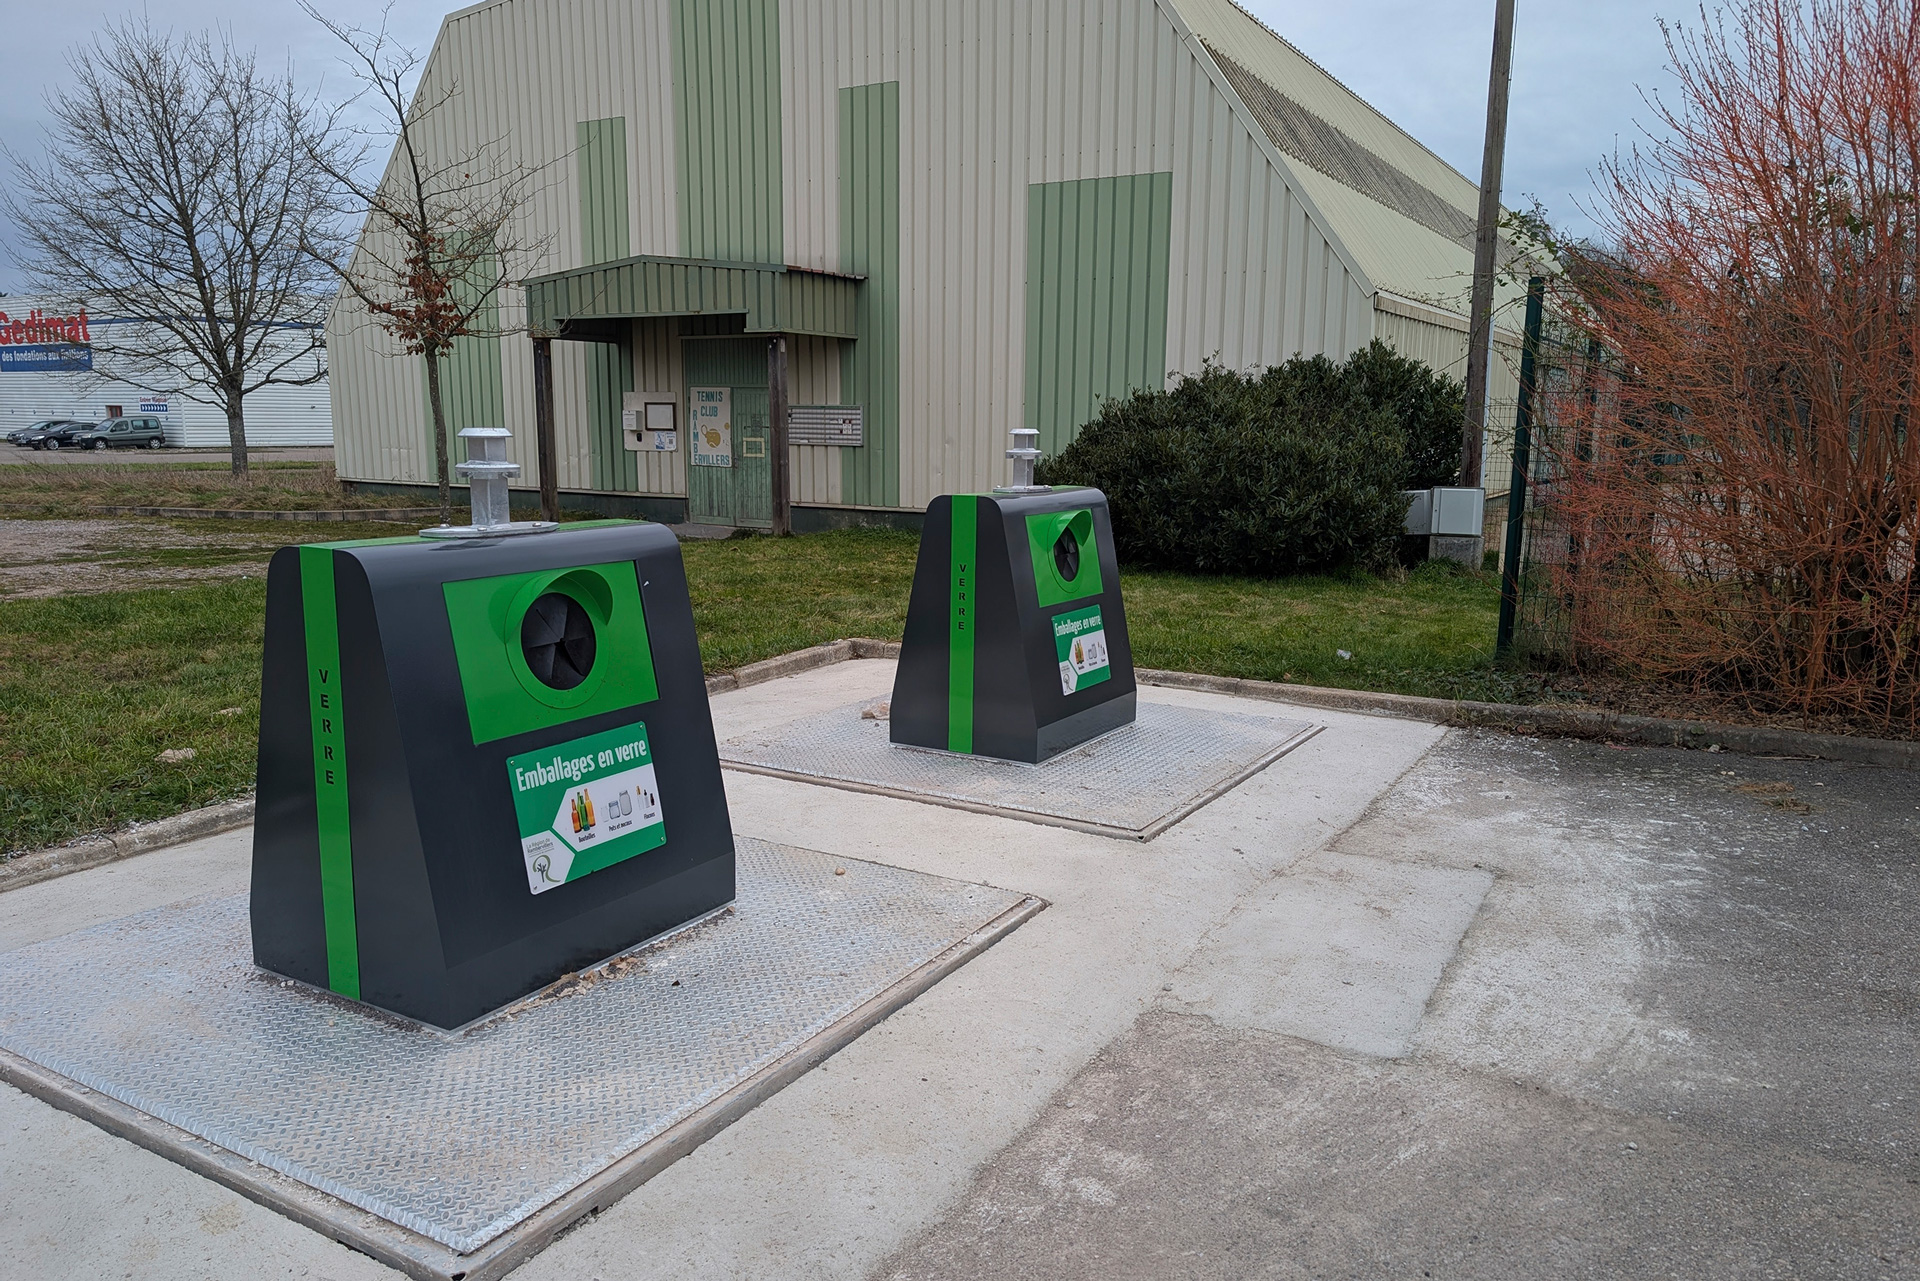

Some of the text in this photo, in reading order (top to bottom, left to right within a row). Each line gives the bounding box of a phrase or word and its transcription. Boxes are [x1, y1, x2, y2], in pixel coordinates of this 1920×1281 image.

[0, 308, 91, 345] Gedimat
[1, 350, 14, 362] des
[47, 351, 61, 361] aux
[697, 391, 723, 402] TENNIS
[700, 405, 719, 417] CLUB
[958, 563, 967, 630] VERRE
[1054, 614, 1101, 637] Emballages en verre
[318, 668, 335, 785] VERRE
[515, 740, 648, 792] Emballages en verre
